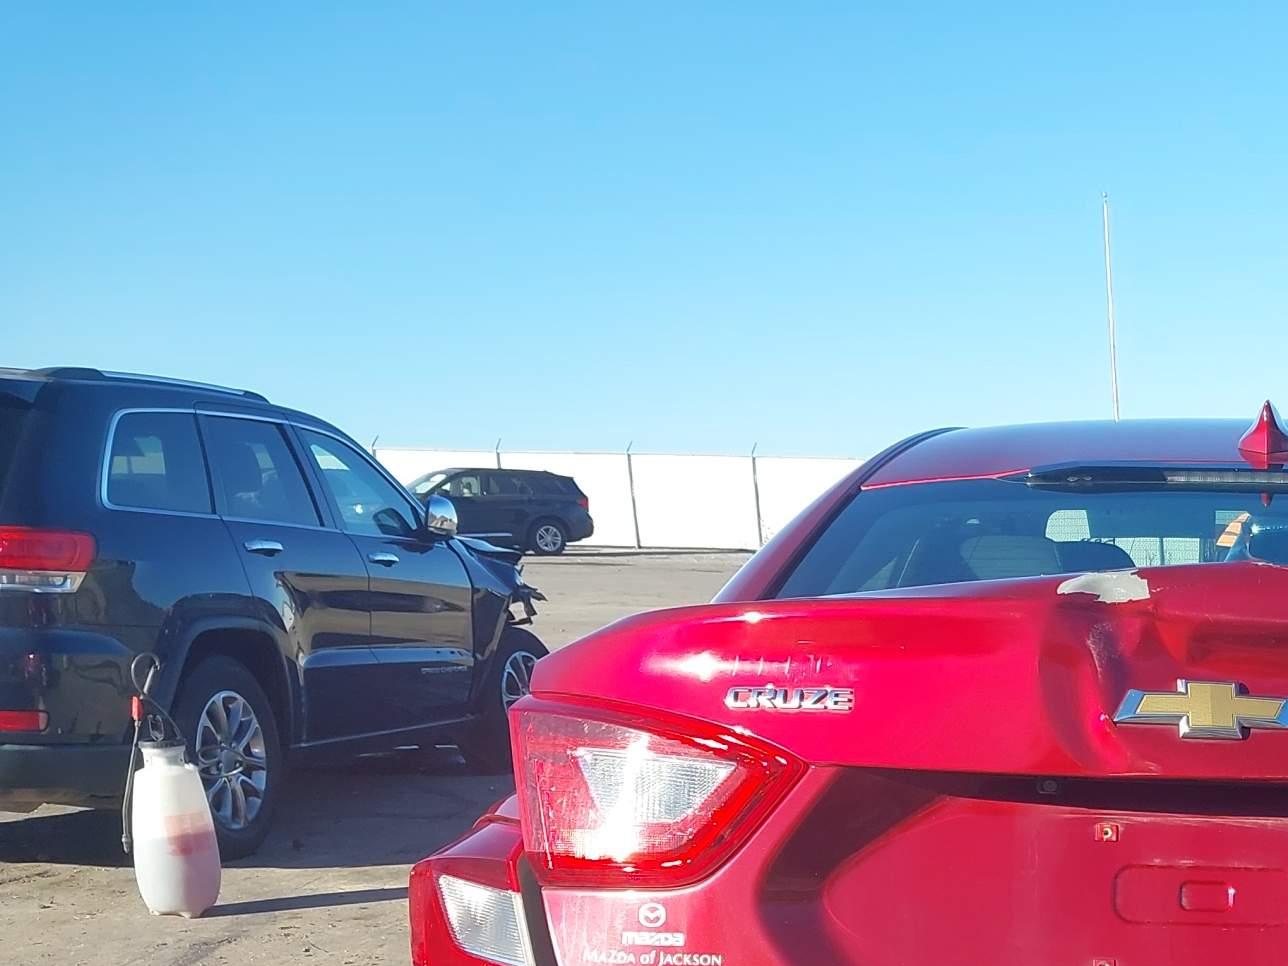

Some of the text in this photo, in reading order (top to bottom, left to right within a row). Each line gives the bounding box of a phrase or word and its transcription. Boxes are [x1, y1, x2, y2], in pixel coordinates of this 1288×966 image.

[724, 686, 855, 712] CRUZE
[640, 950, 656, 964] of
[658, 952, 722, 966] JACKSON
